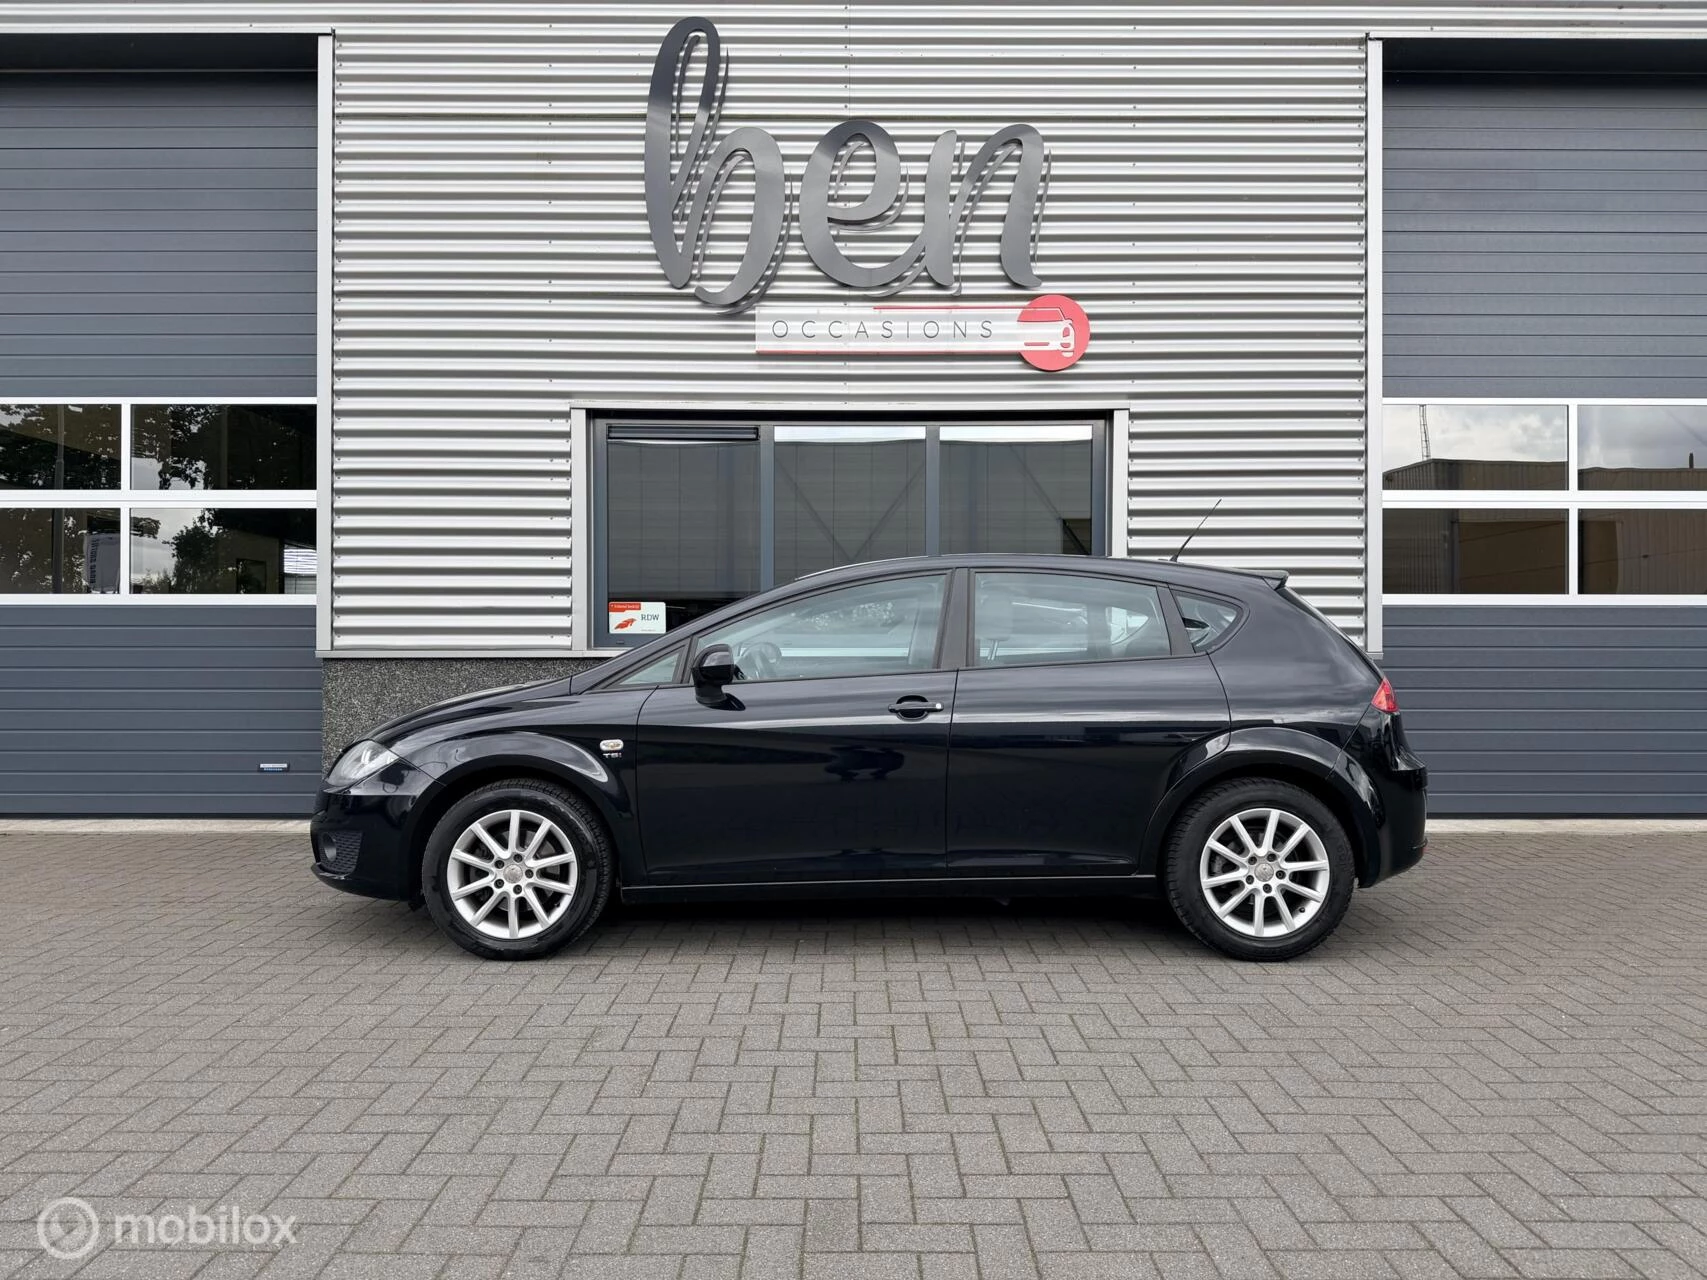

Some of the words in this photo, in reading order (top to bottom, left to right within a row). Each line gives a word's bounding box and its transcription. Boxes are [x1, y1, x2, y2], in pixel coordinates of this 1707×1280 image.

[644, 16, 1044, 305] ben
[771, 319, 994, 340] OCCASIONS
[640, 613, 660, 621] RDW
